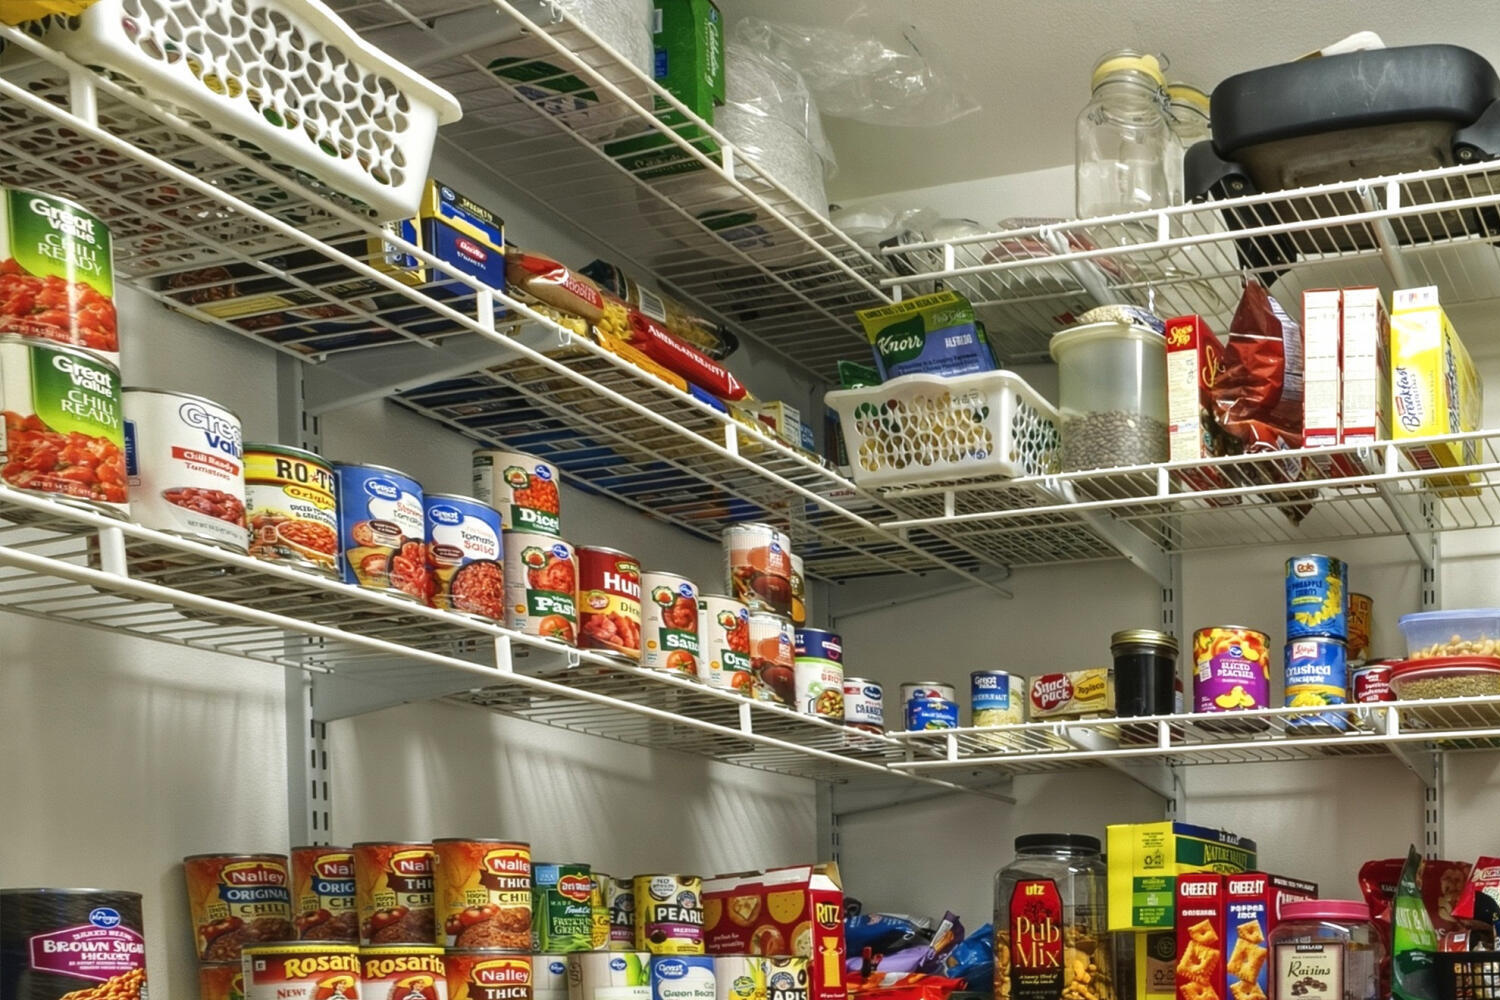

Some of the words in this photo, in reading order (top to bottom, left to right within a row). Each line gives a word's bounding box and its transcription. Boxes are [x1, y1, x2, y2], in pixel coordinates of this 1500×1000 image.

[30, 198, 95, 235] Great
[47, 216, 96, 244] Value
[37, 242, 103, 276] READY
[876, 334, 924, 356] Knorr
[53, 355, 113, 389] Great
[70, 374, 114, 399] Value
[61, 399, 119, 429] READY
[68, 389, 115, 416] CHILI
[205, 432, 243, 459] Valu
[604, 571, 641, 600] Hun
[535, 596, 577, 619] Past
[1034, 674, 1070, 695] Snack
[231, 871, 285, 885] Nalley
[1025, 884, 1045, 896] utz
[226, 888, 289, 901] ORIGINAL
[239, 904, 286, 915] CHILI
[815, 901, 840, 923] RITZ
[1016, 917, 1060, 943] Pub
[43, 939, 108, 954] BROWN
[1014, 943, 1060, 969] Mix
[284, 953, 361, 978] Rosarit
[481, 970, 529, 983] Nalley
[1287, 960, 1331, 978] Raisins
[485, 987, 528, 1000] THICK
